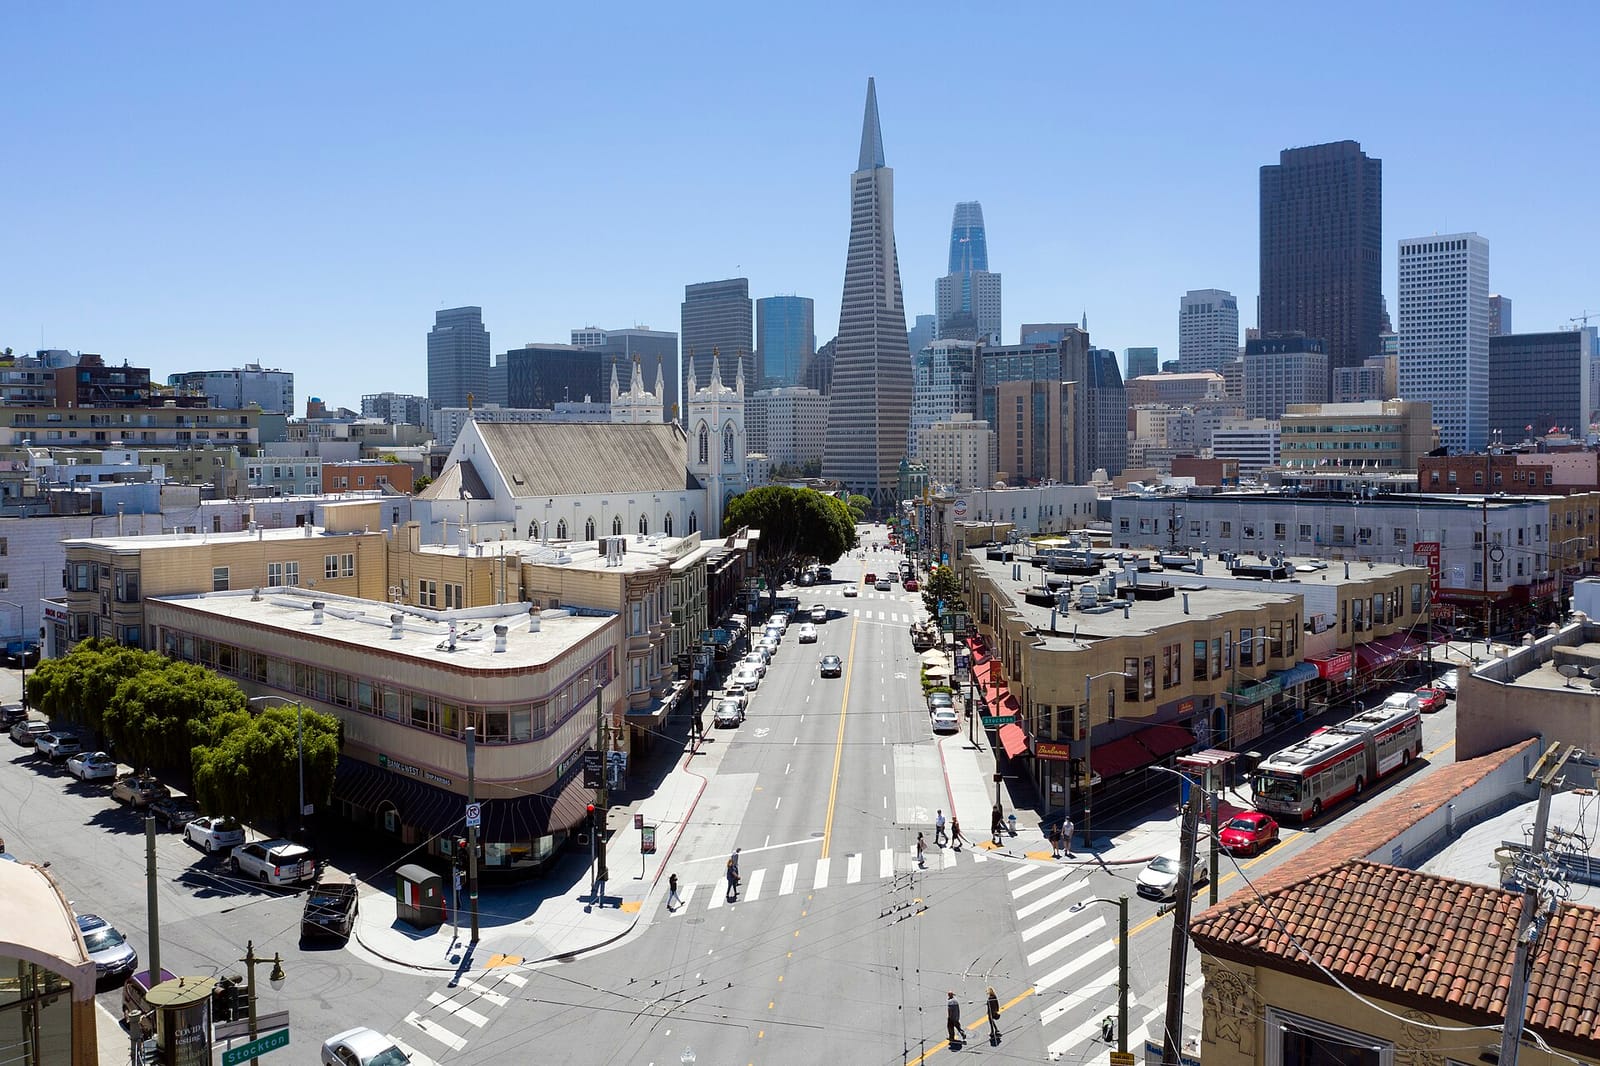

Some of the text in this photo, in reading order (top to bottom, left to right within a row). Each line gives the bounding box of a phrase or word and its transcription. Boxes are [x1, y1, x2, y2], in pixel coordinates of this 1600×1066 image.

[1416, 544, 1438, 552] Little
[1430, 556, 1439, 600] CITY
[174, 1024, 201, 1037] COVID
[228, 1035, 285, 1063] Stockton
